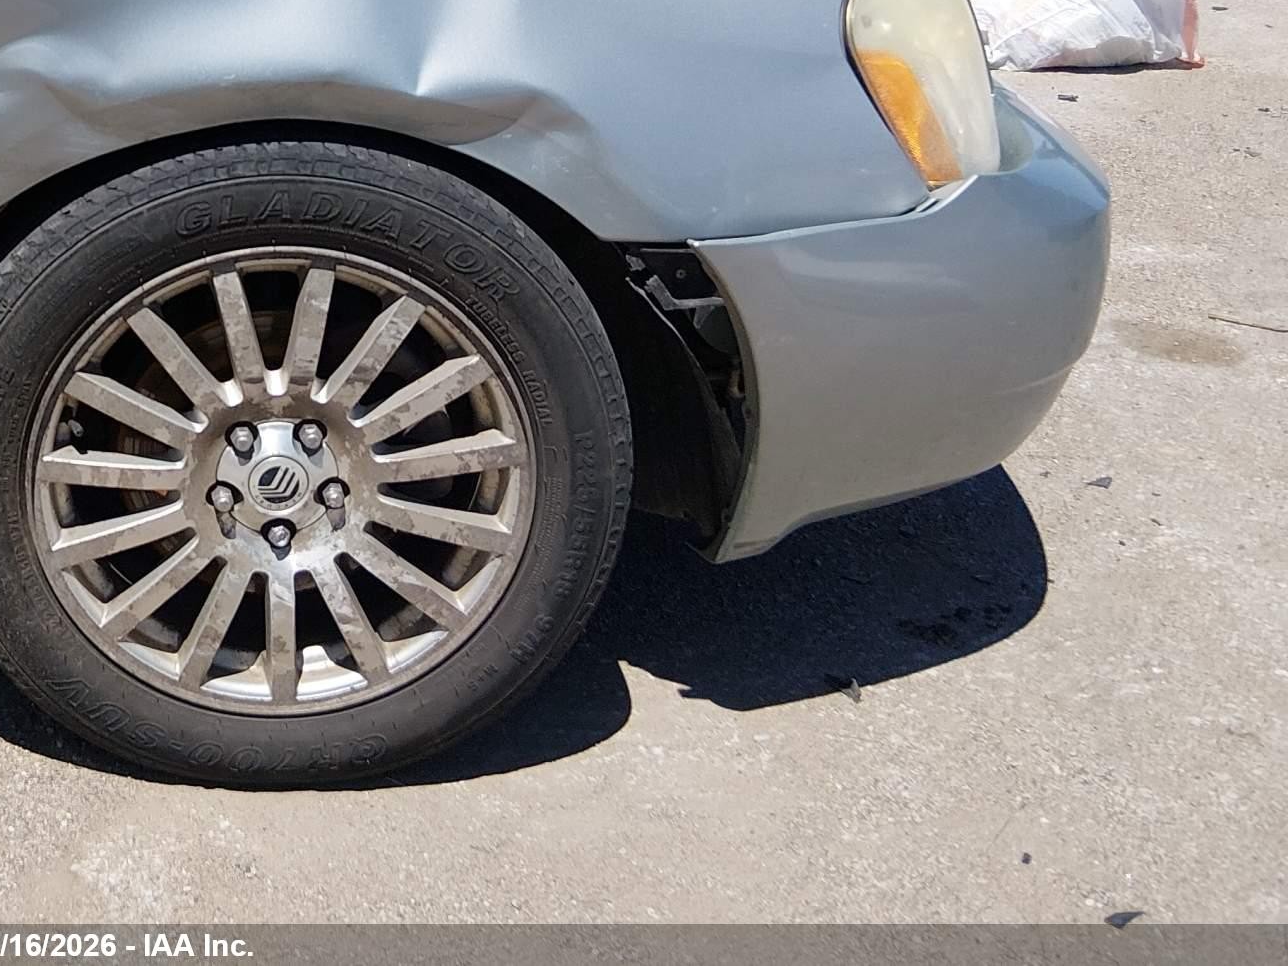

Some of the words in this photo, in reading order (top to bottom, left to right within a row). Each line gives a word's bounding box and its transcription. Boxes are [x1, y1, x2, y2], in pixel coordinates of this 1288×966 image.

[175, 191, 519, 305] GLADIATOR
[464, 293, 527, 366] TUBELESS
[522, 369, 555, 427] RADIAL
